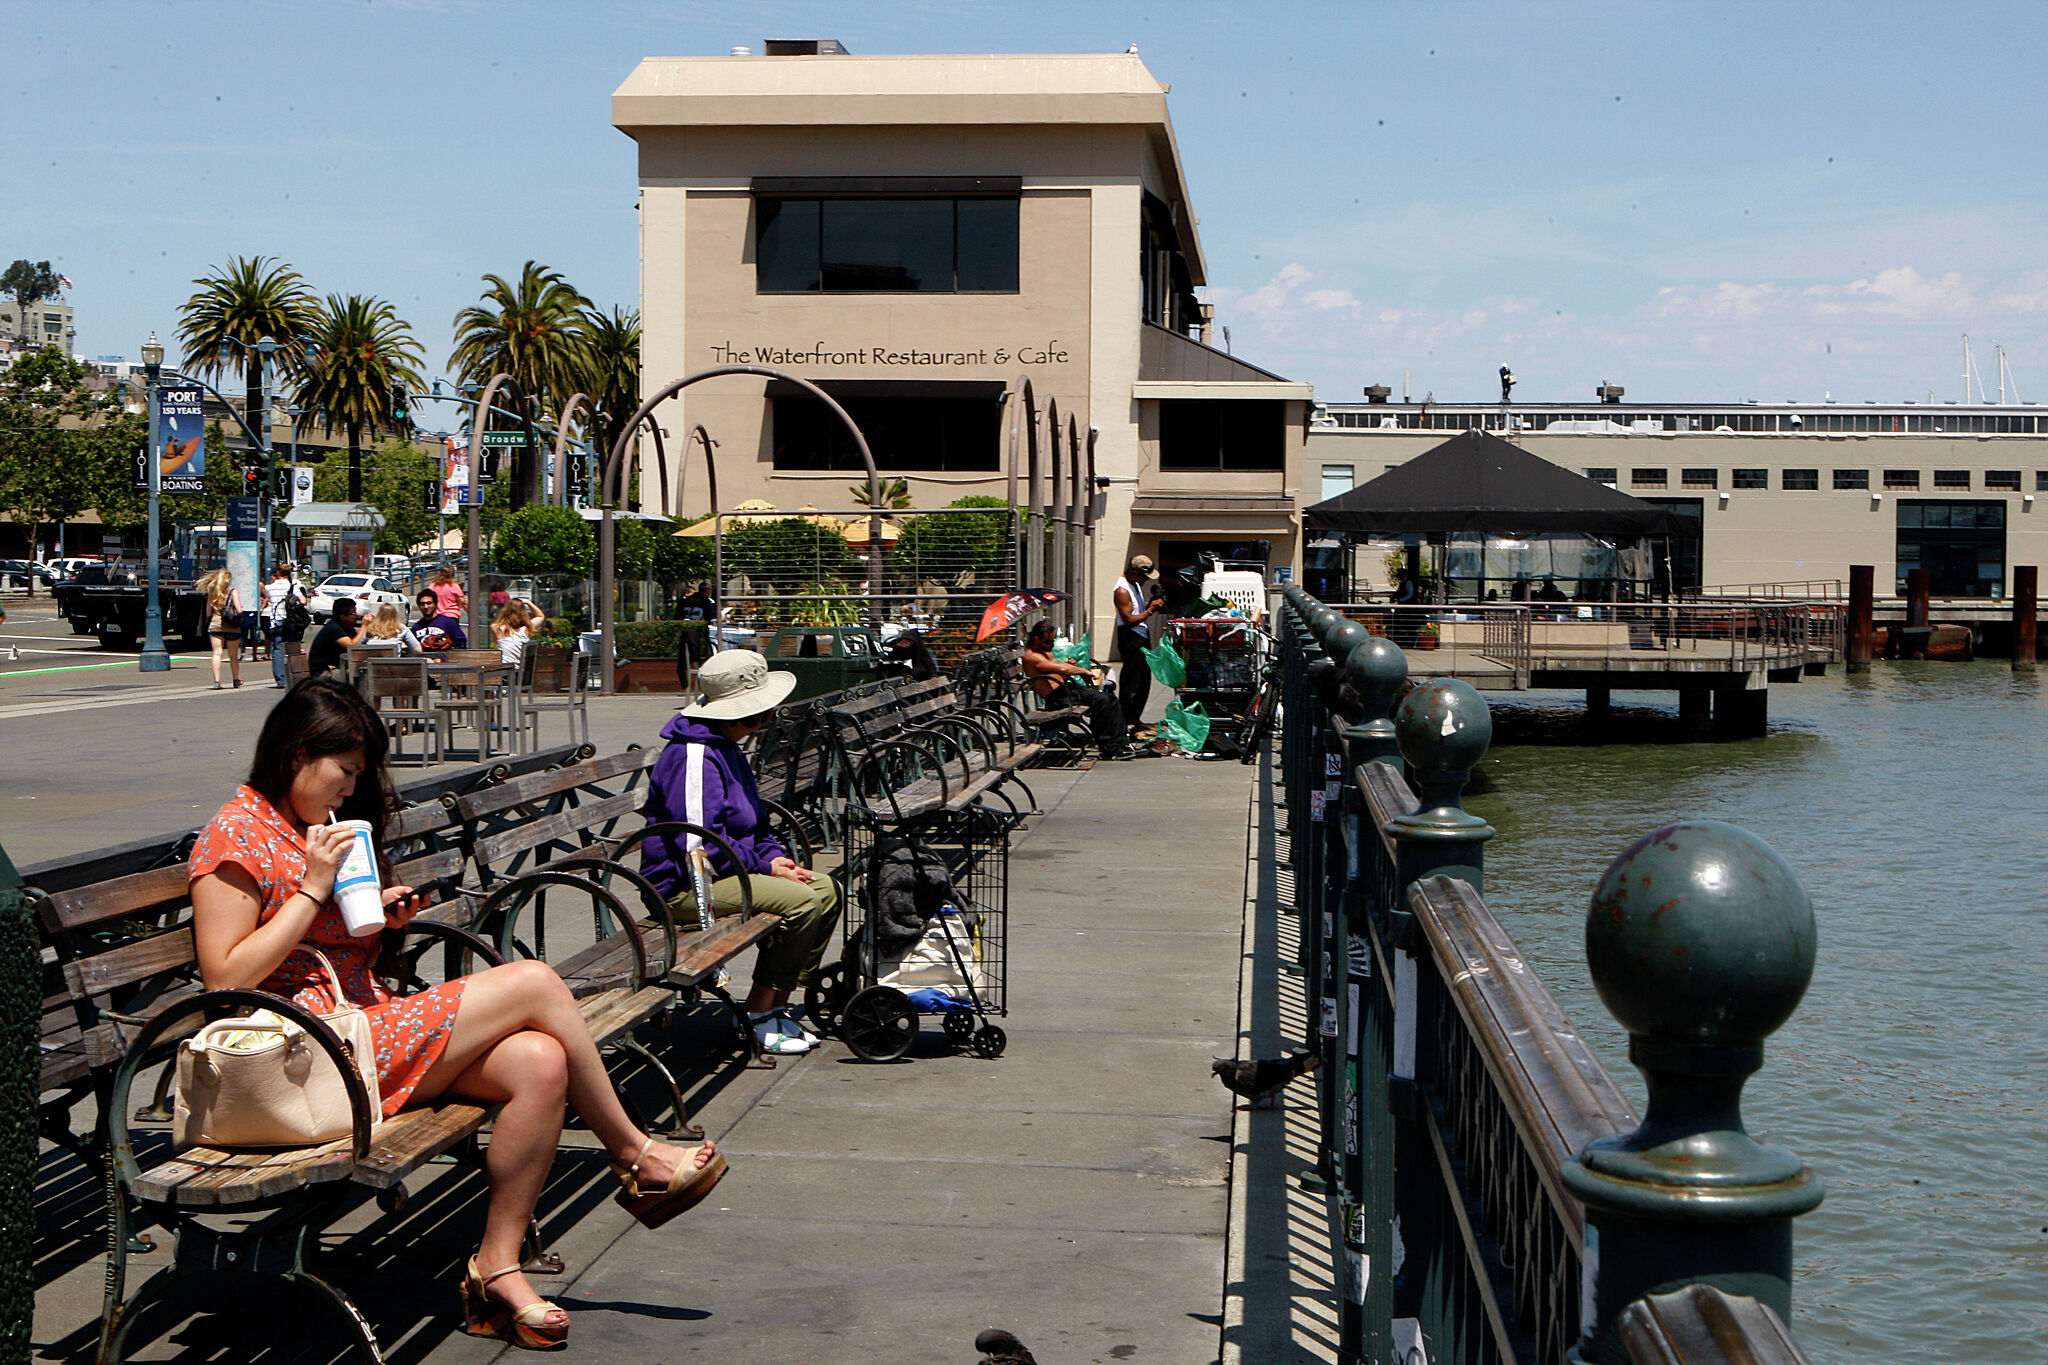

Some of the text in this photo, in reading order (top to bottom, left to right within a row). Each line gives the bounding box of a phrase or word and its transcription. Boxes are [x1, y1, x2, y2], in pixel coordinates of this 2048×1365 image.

[710, 339, 1070, 365] The Waterfront Restaurant & Cafe
[167, 391, 197, 402] PORT
[162, 407, 202, 415] 150 YEARS
[483, 434, 538, 443] Broadwy
[162, 480, 203, 490] BOATING
